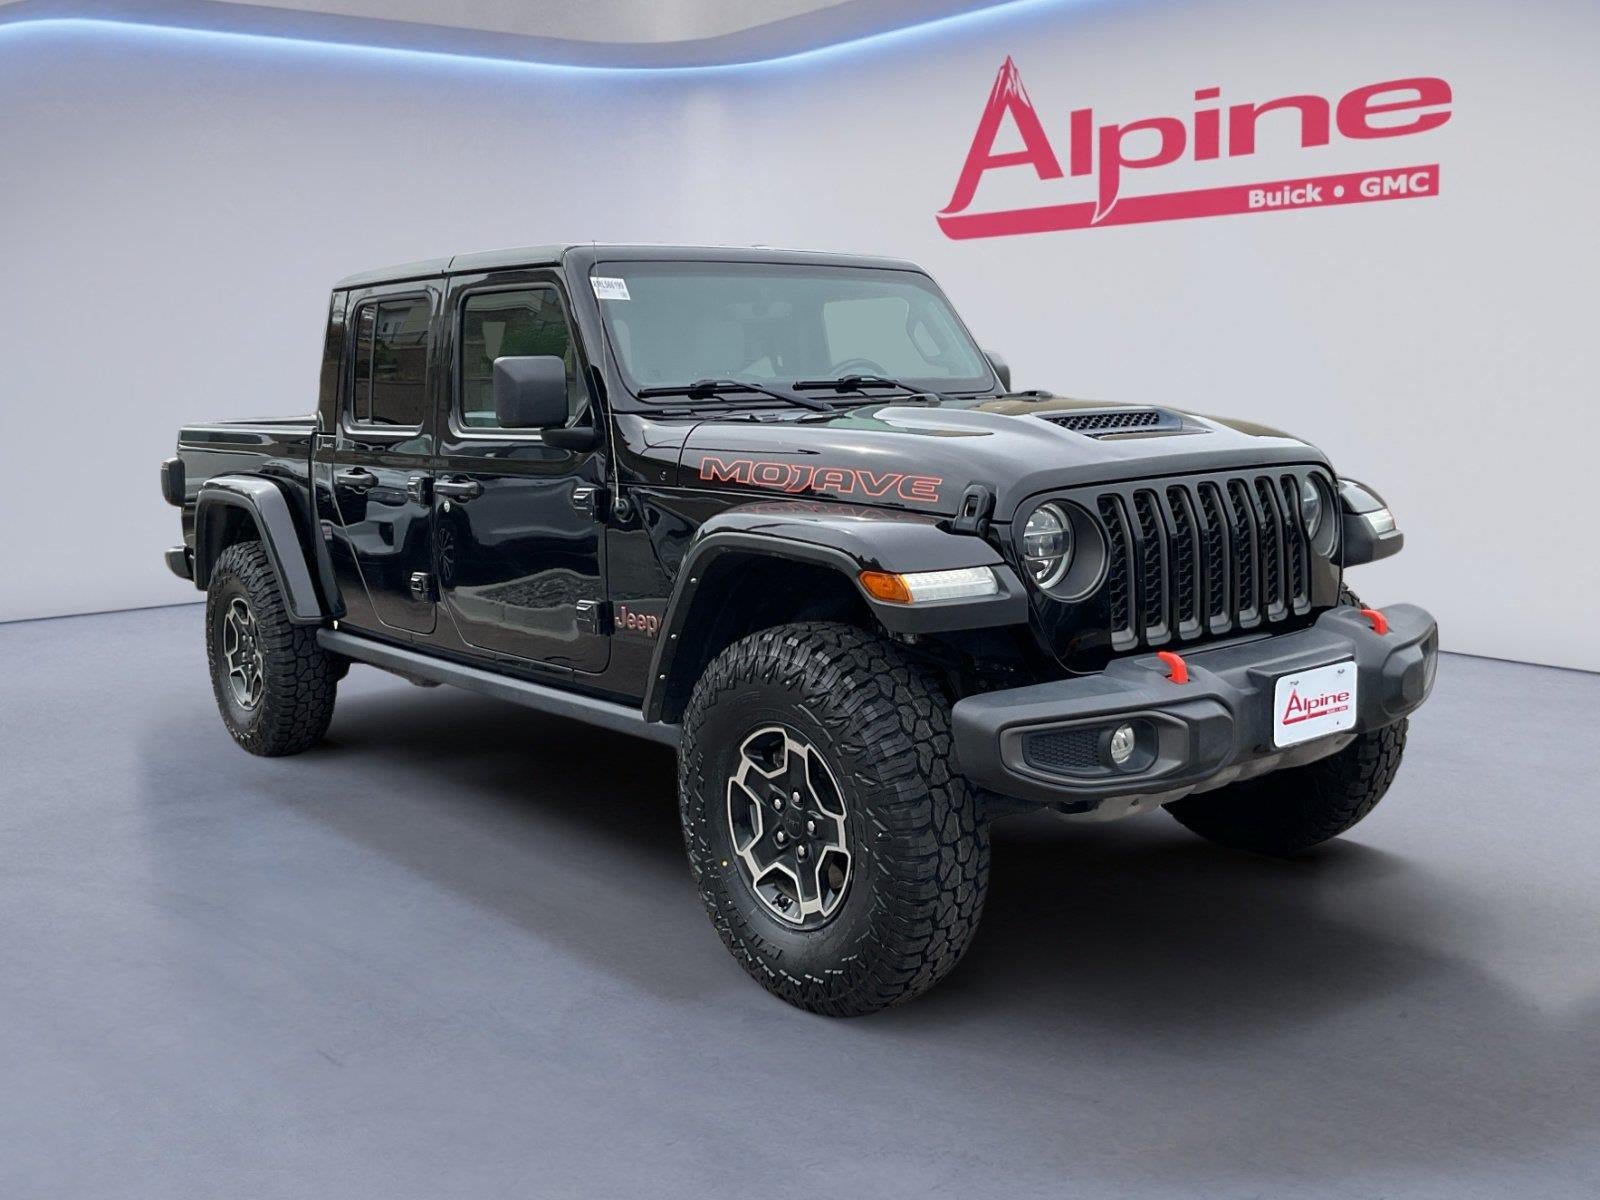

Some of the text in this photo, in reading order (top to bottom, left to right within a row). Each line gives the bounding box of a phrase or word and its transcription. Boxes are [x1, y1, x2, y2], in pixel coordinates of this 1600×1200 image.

[936, 54, 1453, 224] Alpine
[1248, 171, 1431, 209] Buick GMC
[700, 457, 943, 502] MOJAVE
[614, 605, 658, 638] Jeep
[1283, 688, 1350, 720] Alpine
